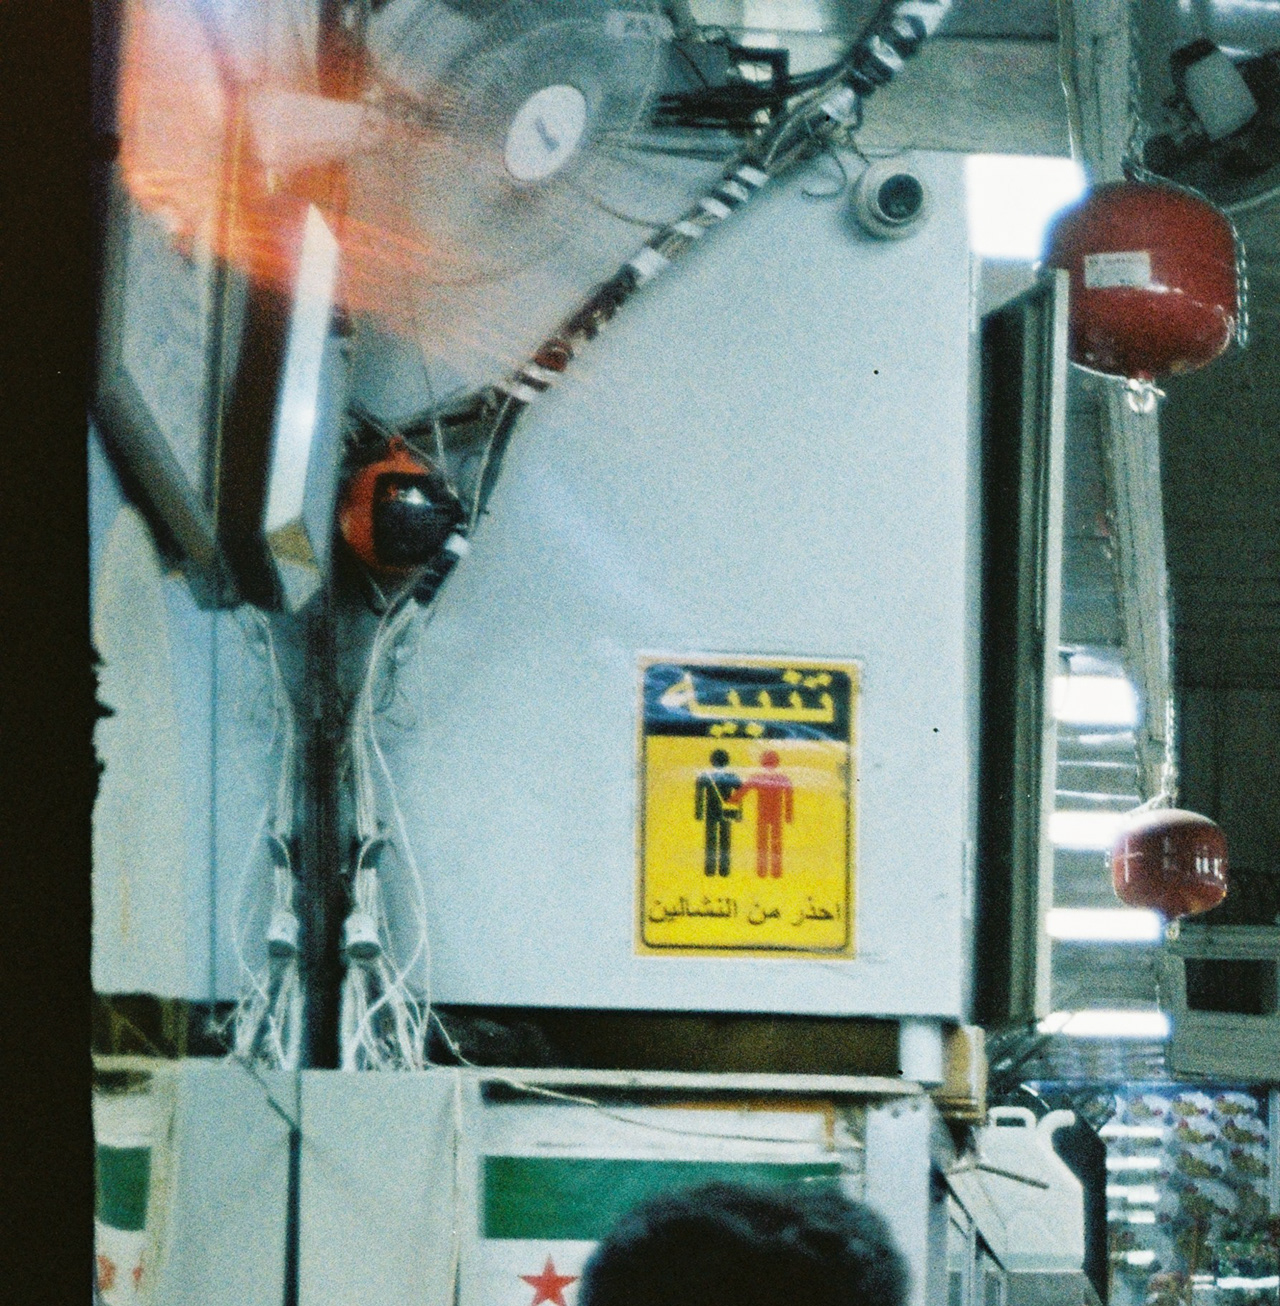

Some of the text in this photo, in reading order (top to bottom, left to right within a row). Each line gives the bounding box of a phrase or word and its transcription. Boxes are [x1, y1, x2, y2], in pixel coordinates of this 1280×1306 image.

[660, 670, 835, 738] تنبيه
[648, 896, 842, 927] احذر من النشالين
